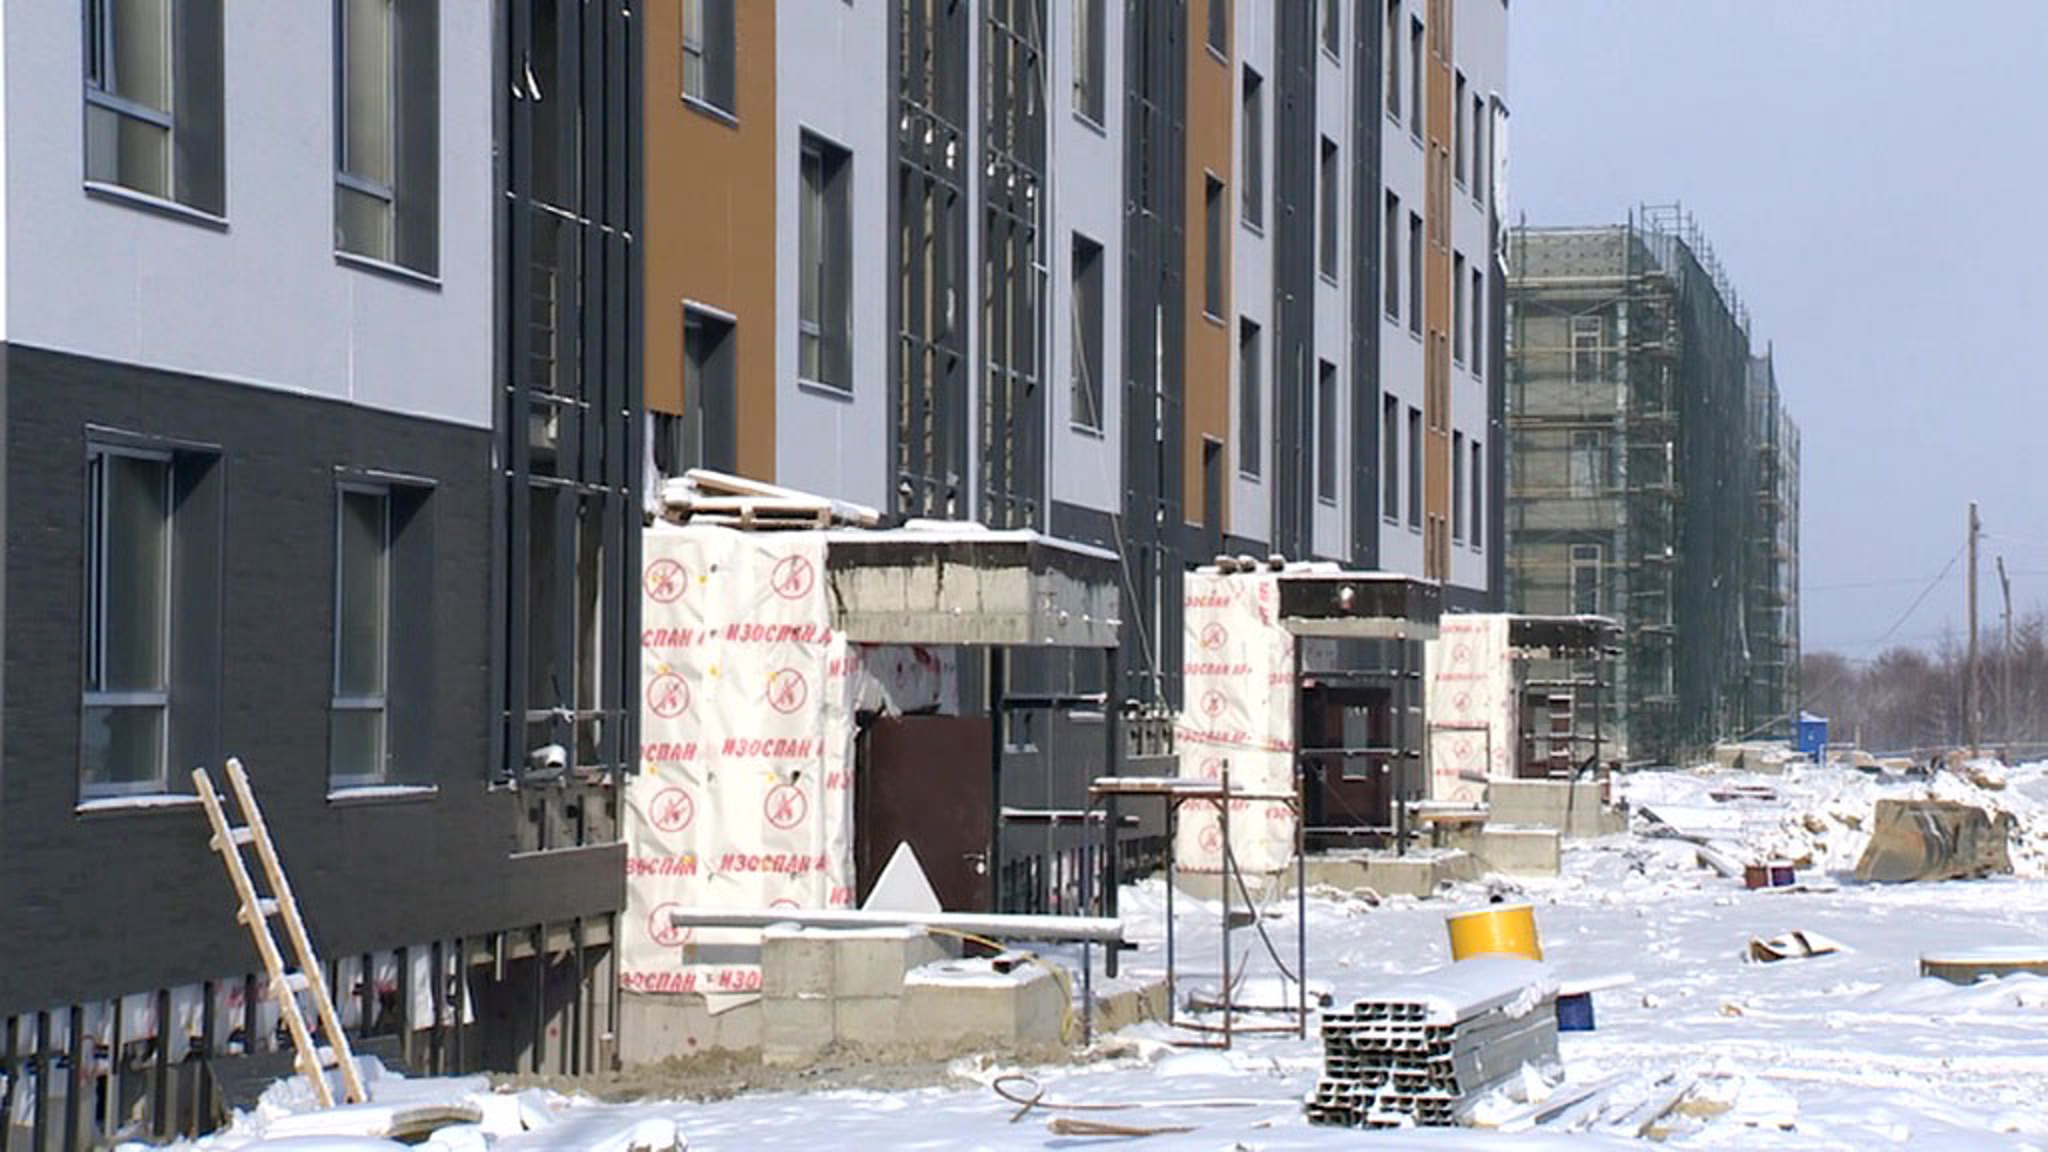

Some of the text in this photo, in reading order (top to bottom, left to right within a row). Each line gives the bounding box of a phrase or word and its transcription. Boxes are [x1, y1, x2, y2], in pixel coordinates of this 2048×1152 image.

[726, 623, 817, 642] ИЗОСПАН
[722, 738, 812, 758] ИЗОСПАН
[721, 853, 811, 873] ИЗОСПАН
